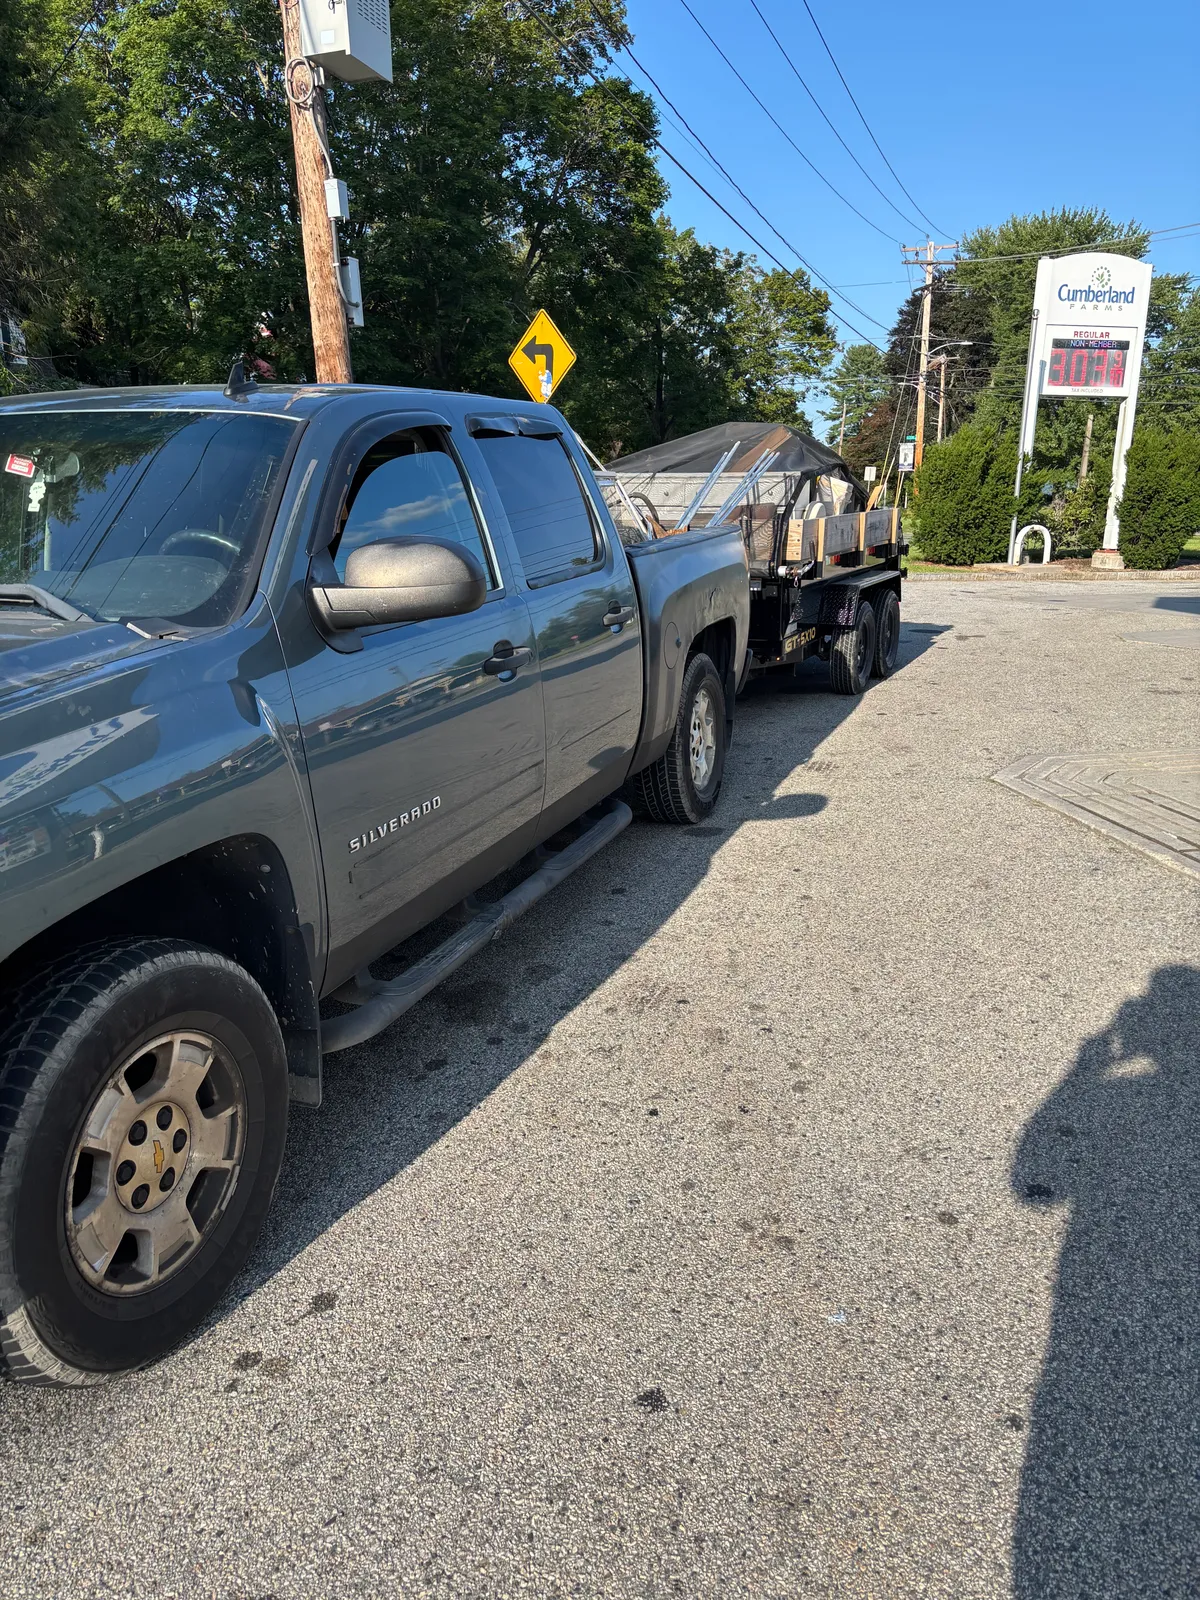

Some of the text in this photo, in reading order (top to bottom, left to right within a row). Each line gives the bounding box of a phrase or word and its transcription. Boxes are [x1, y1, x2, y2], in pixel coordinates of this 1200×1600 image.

[1058, 284, 1135, 304] Cumberland
[1069, 303, 1123, 311] FARMS
[1073, 331, 1110, 339] REGULAR
[1070, 339, 1117, 348] NON-MEMBER
[348, 795, 441, 854] SILVERADO
